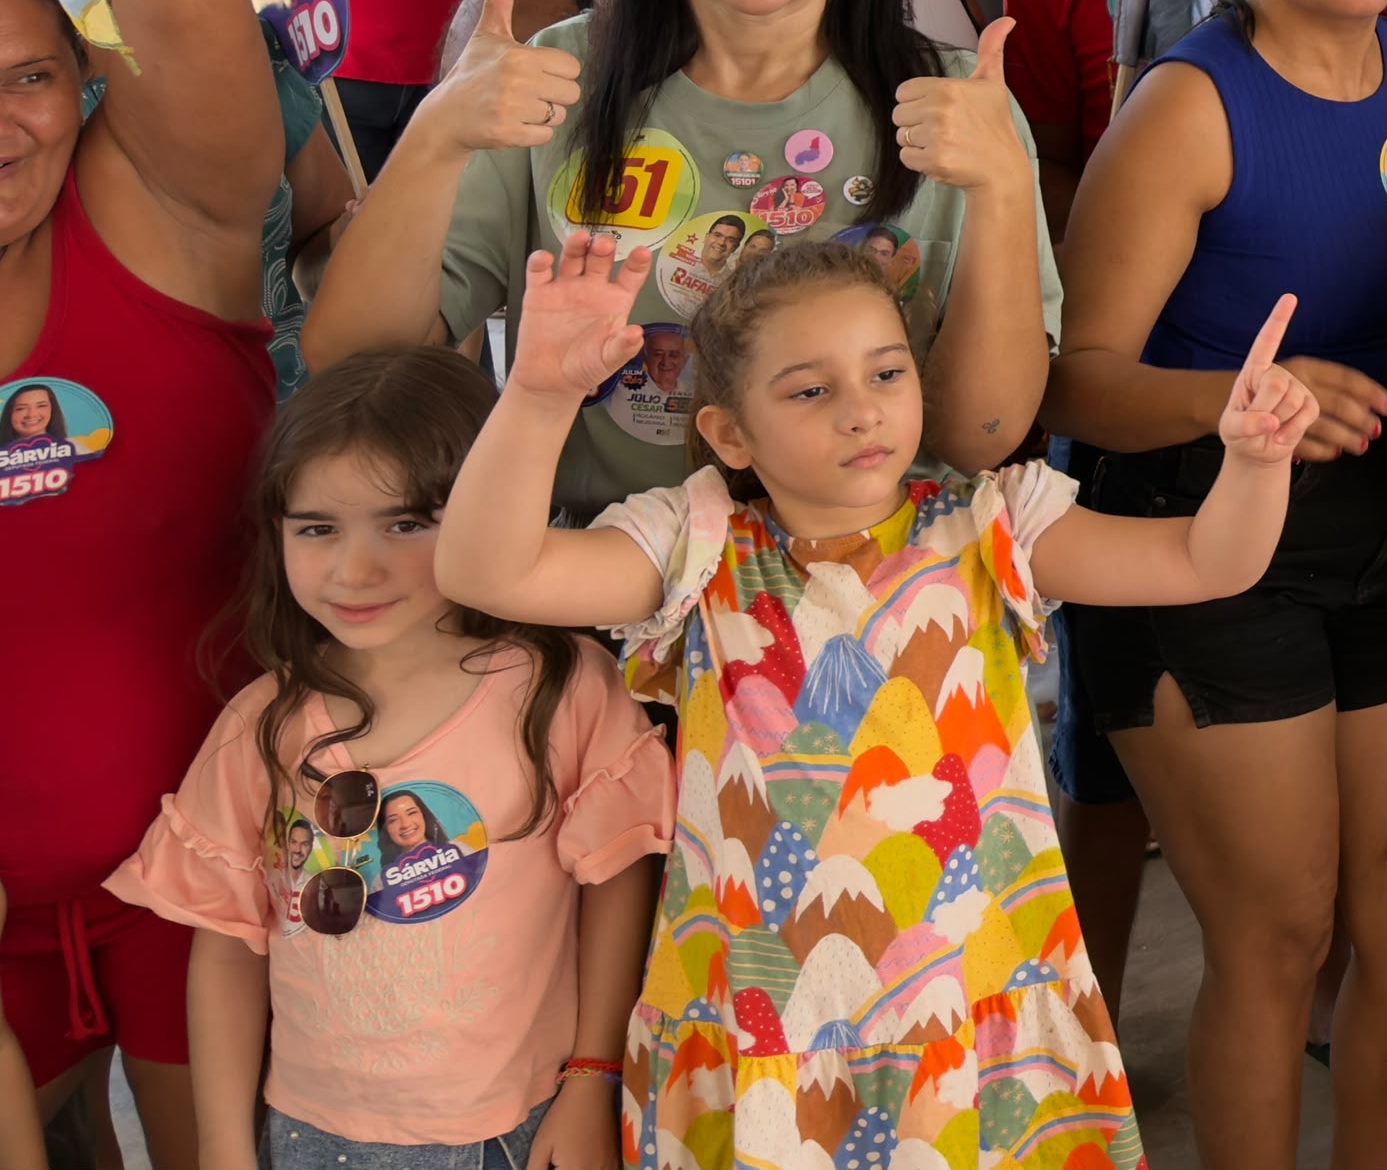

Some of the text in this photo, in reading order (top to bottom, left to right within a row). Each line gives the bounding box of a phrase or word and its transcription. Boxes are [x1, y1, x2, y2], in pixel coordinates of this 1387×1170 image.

[287, 0, 338, 66] 1510
[731, 177, 756, 186] 15101
[0, 468, 68, 499] 1510
[385, 846, 459, 886] Sárvia
[397, 872, 466, 916] 1510
